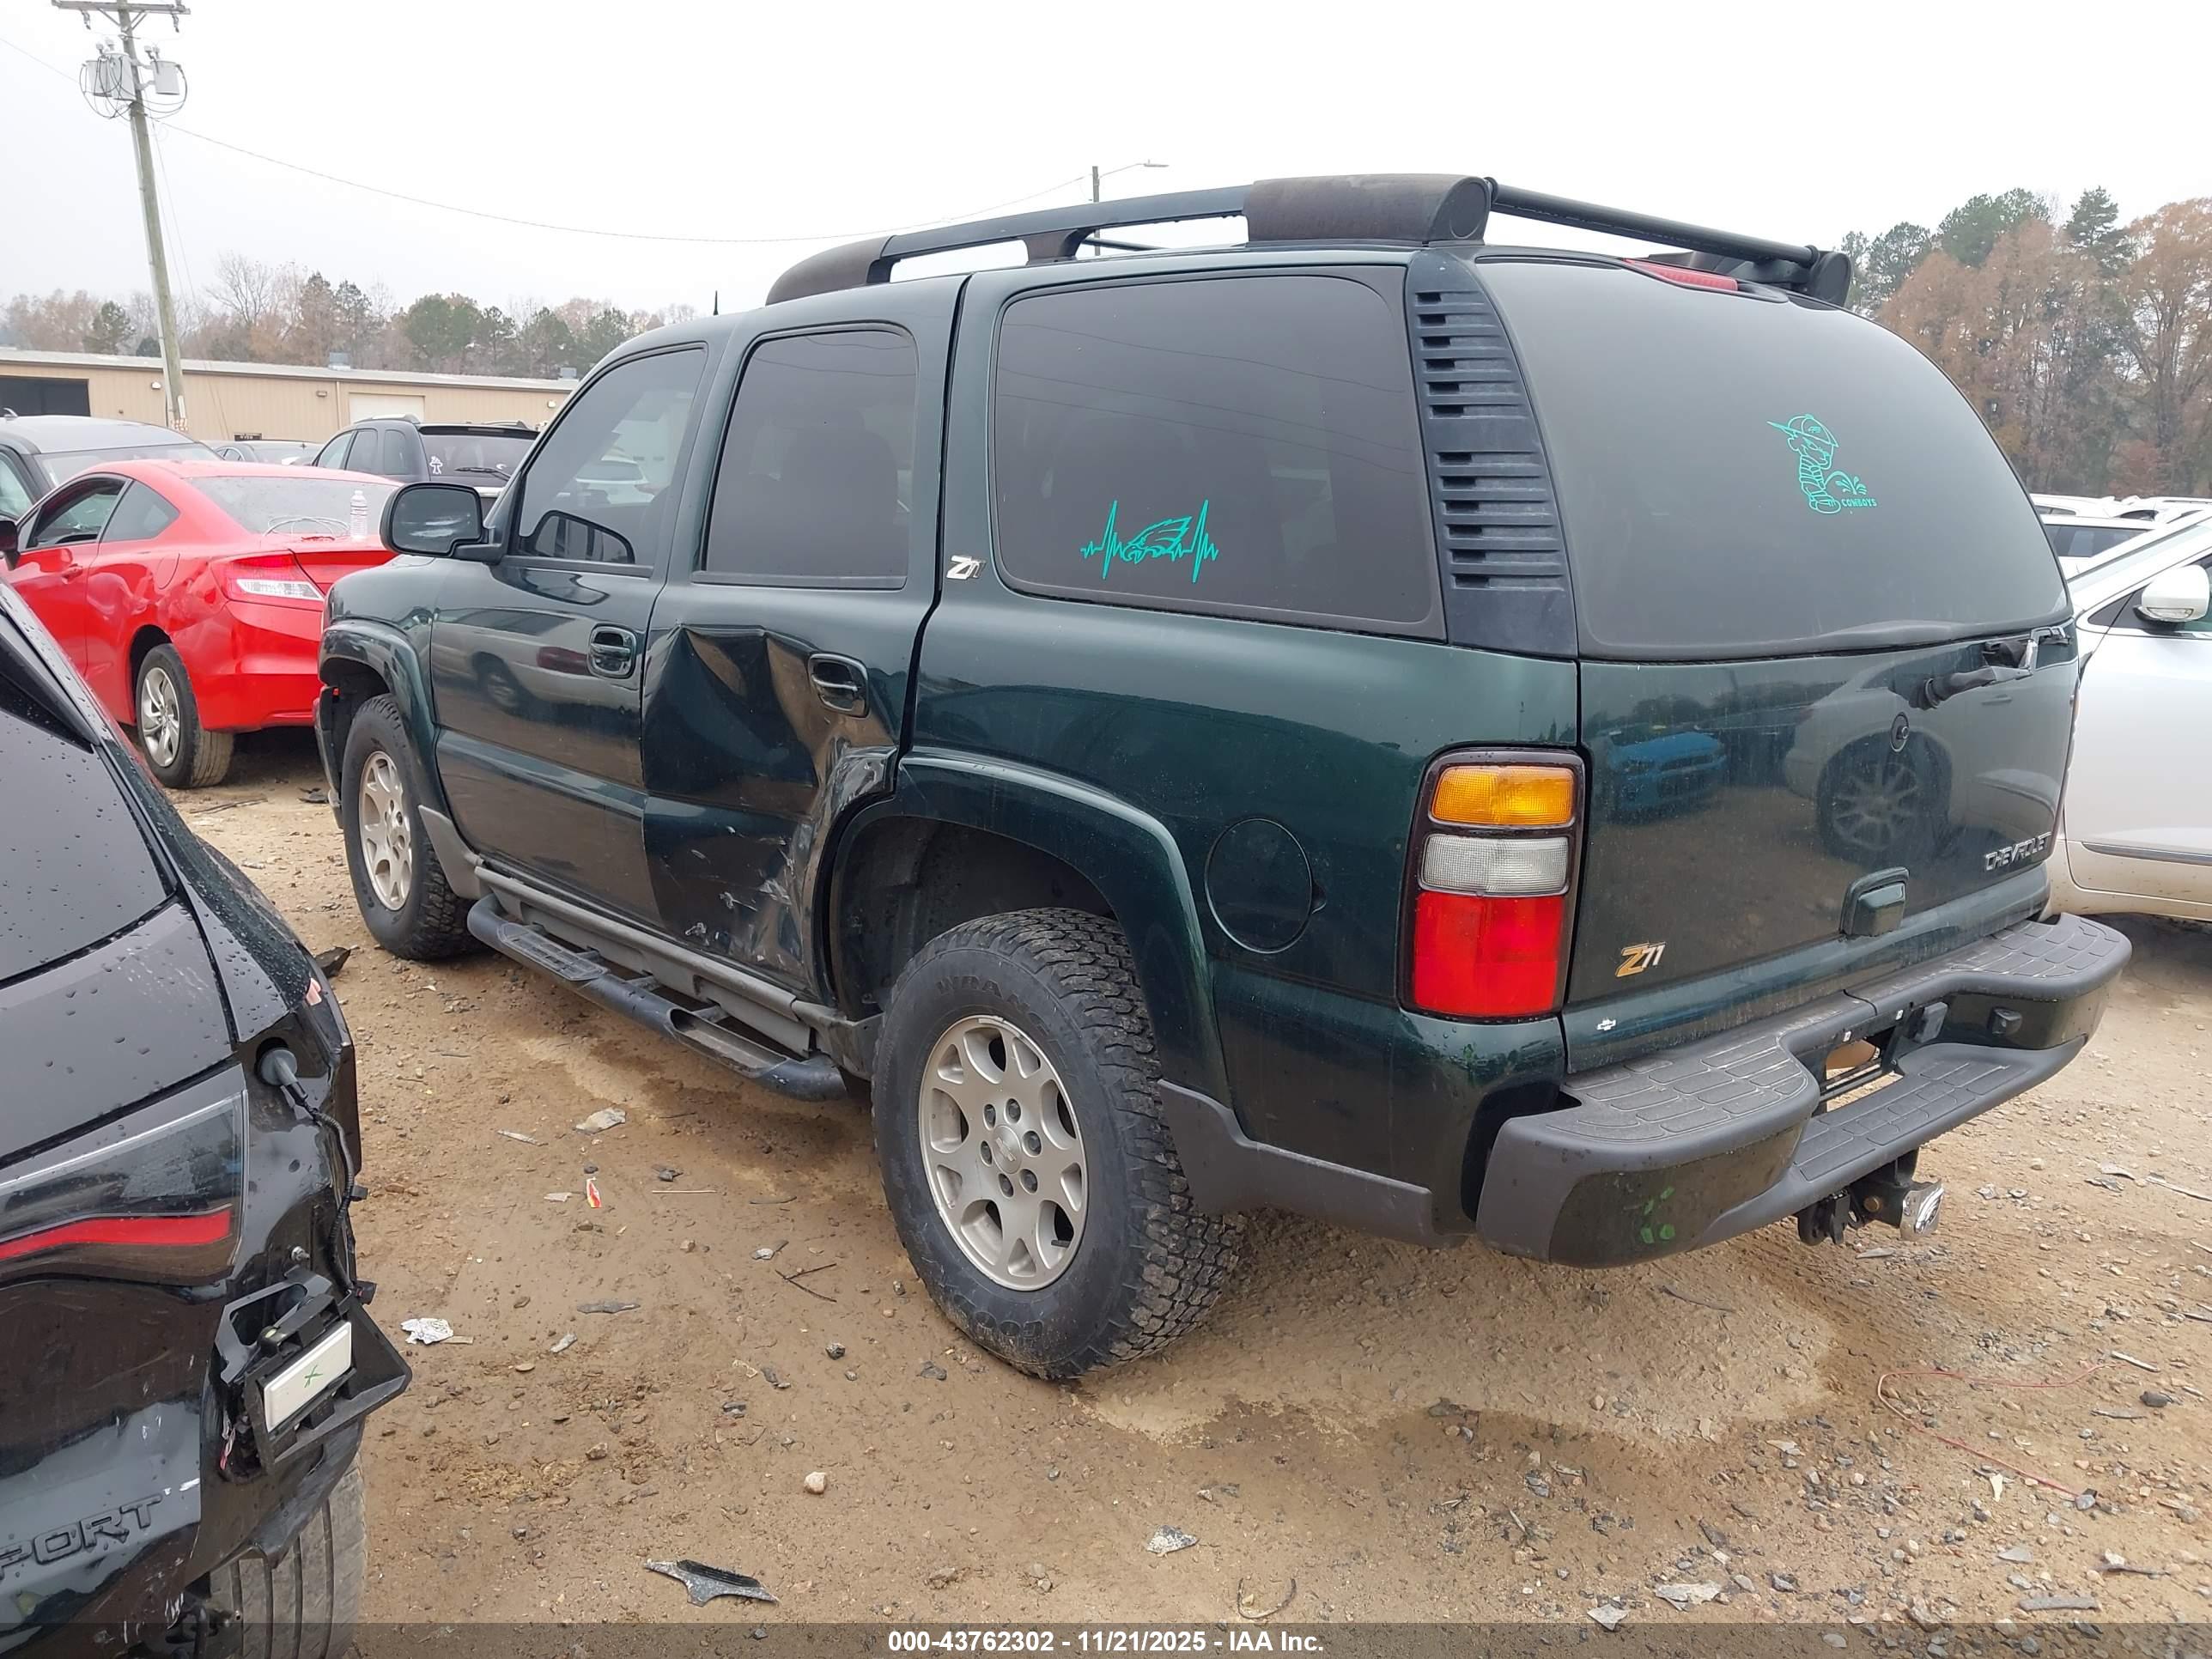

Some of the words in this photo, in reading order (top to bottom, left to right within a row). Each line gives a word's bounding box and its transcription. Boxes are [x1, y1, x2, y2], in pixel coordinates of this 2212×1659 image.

[1840, 498, 1877, 507] COWBOYS
[1984, 831, 2052, 872] CHEVROLET
[1614, 940, 1668, 978] Z71
